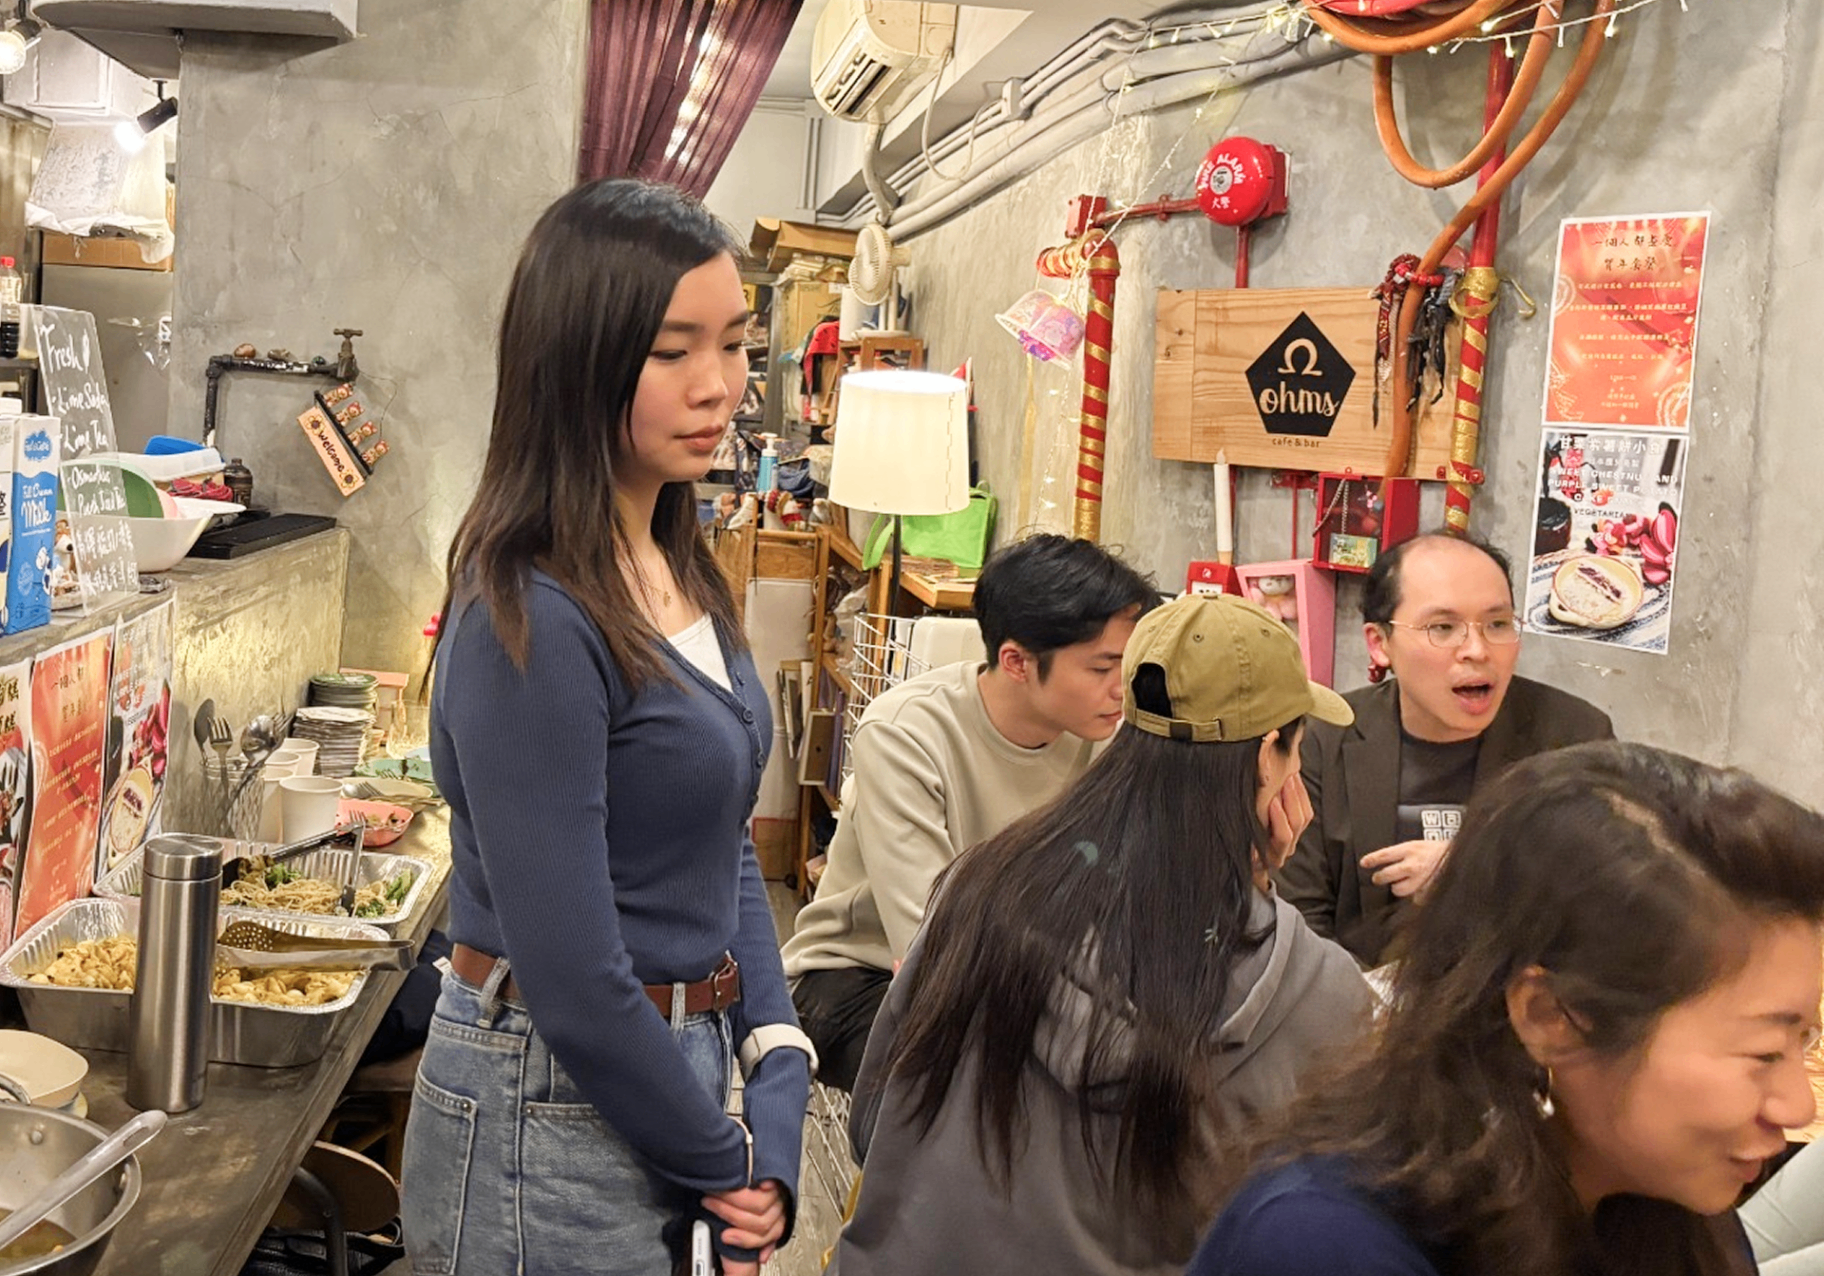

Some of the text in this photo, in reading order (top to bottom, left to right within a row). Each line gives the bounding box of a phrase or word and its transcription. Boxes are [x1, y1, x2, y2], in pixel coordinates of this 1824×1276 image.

[1199, 153, 1247, 189] FIRE ALARM
[1259, 380, 1340, 417] ohms
[1303, 438, 1321, 449] bar
[1591, 470, 1647, 482] CHESTNU
[1655, 474, 1679, 485] AND
[20, 496, 53, 529] Milk
